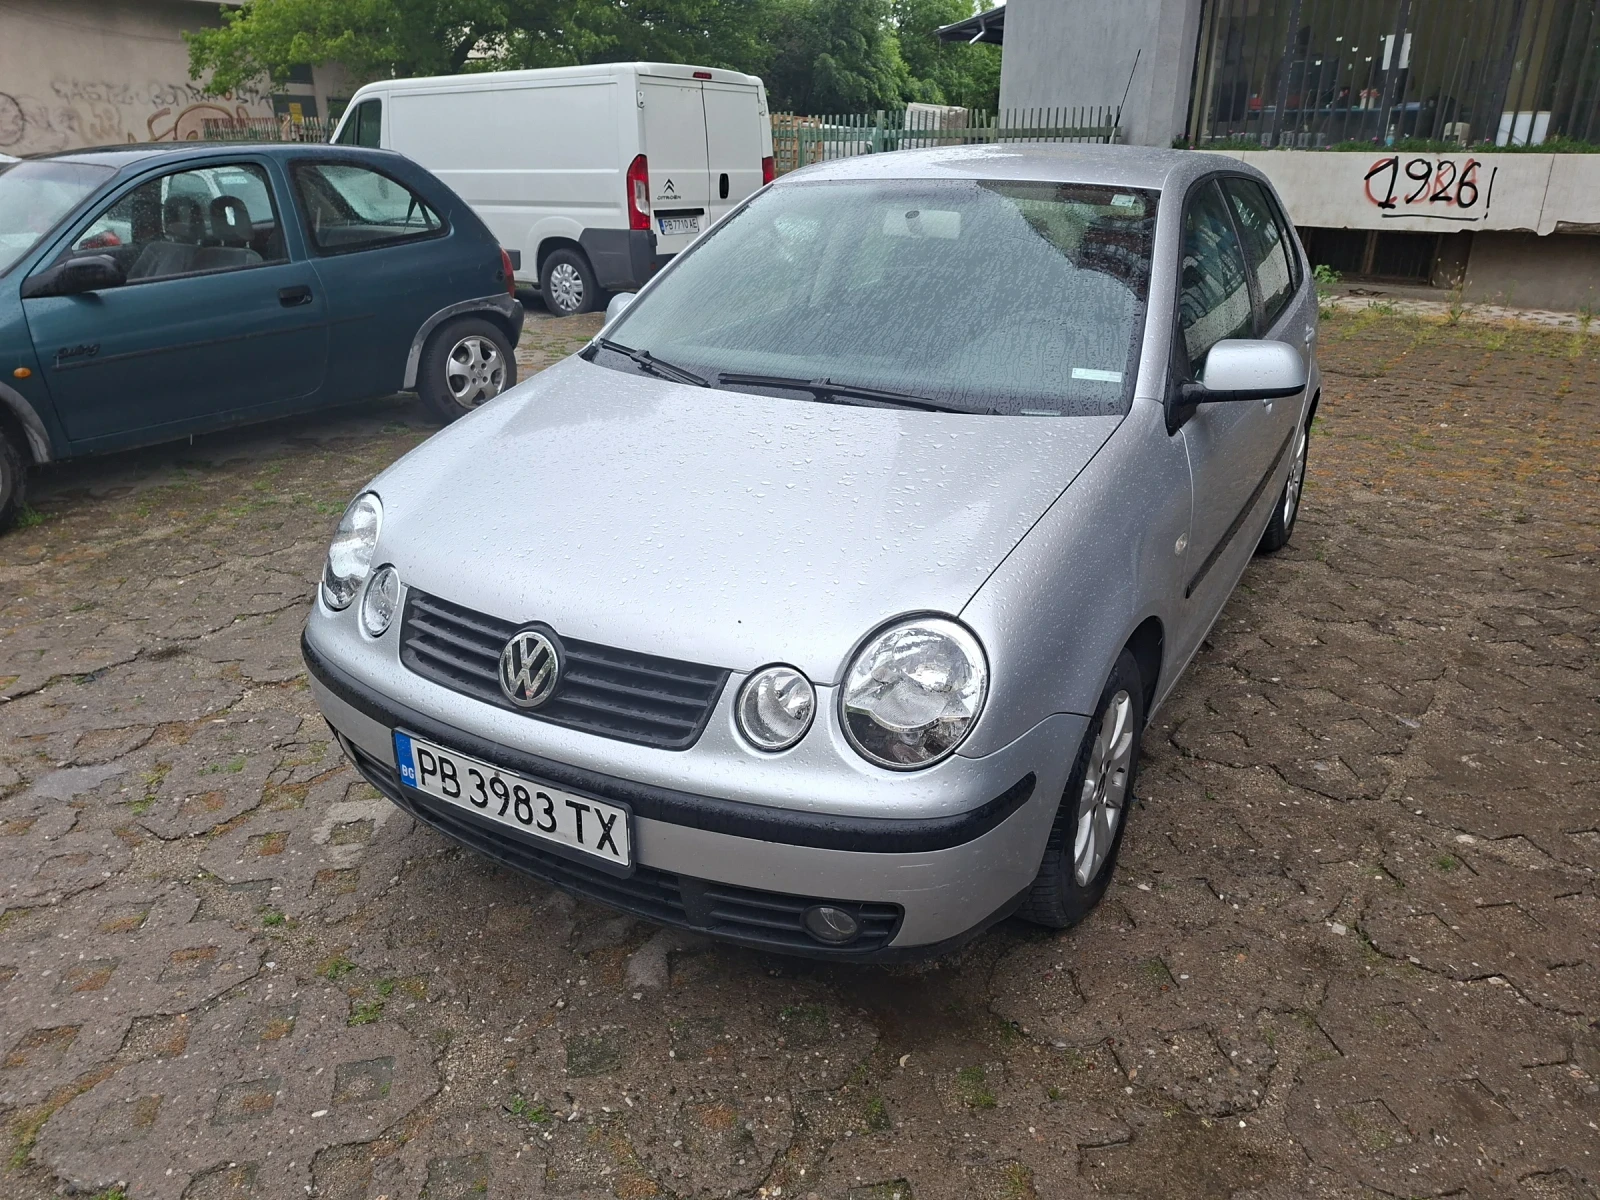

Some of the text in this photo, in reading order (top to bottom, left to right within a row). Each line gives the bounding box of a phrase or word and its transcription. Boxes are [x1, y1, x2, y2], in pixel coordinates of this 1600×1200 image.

[664, 220, 673, 230] PB
[673, 219, 688, 230] 7710
[689, 218, 697, 229] AE
[500, 631, 559, 708] VW
[401, 764, 416, 780] BG
[416, 747, 621, 857] PB 3983 TX
